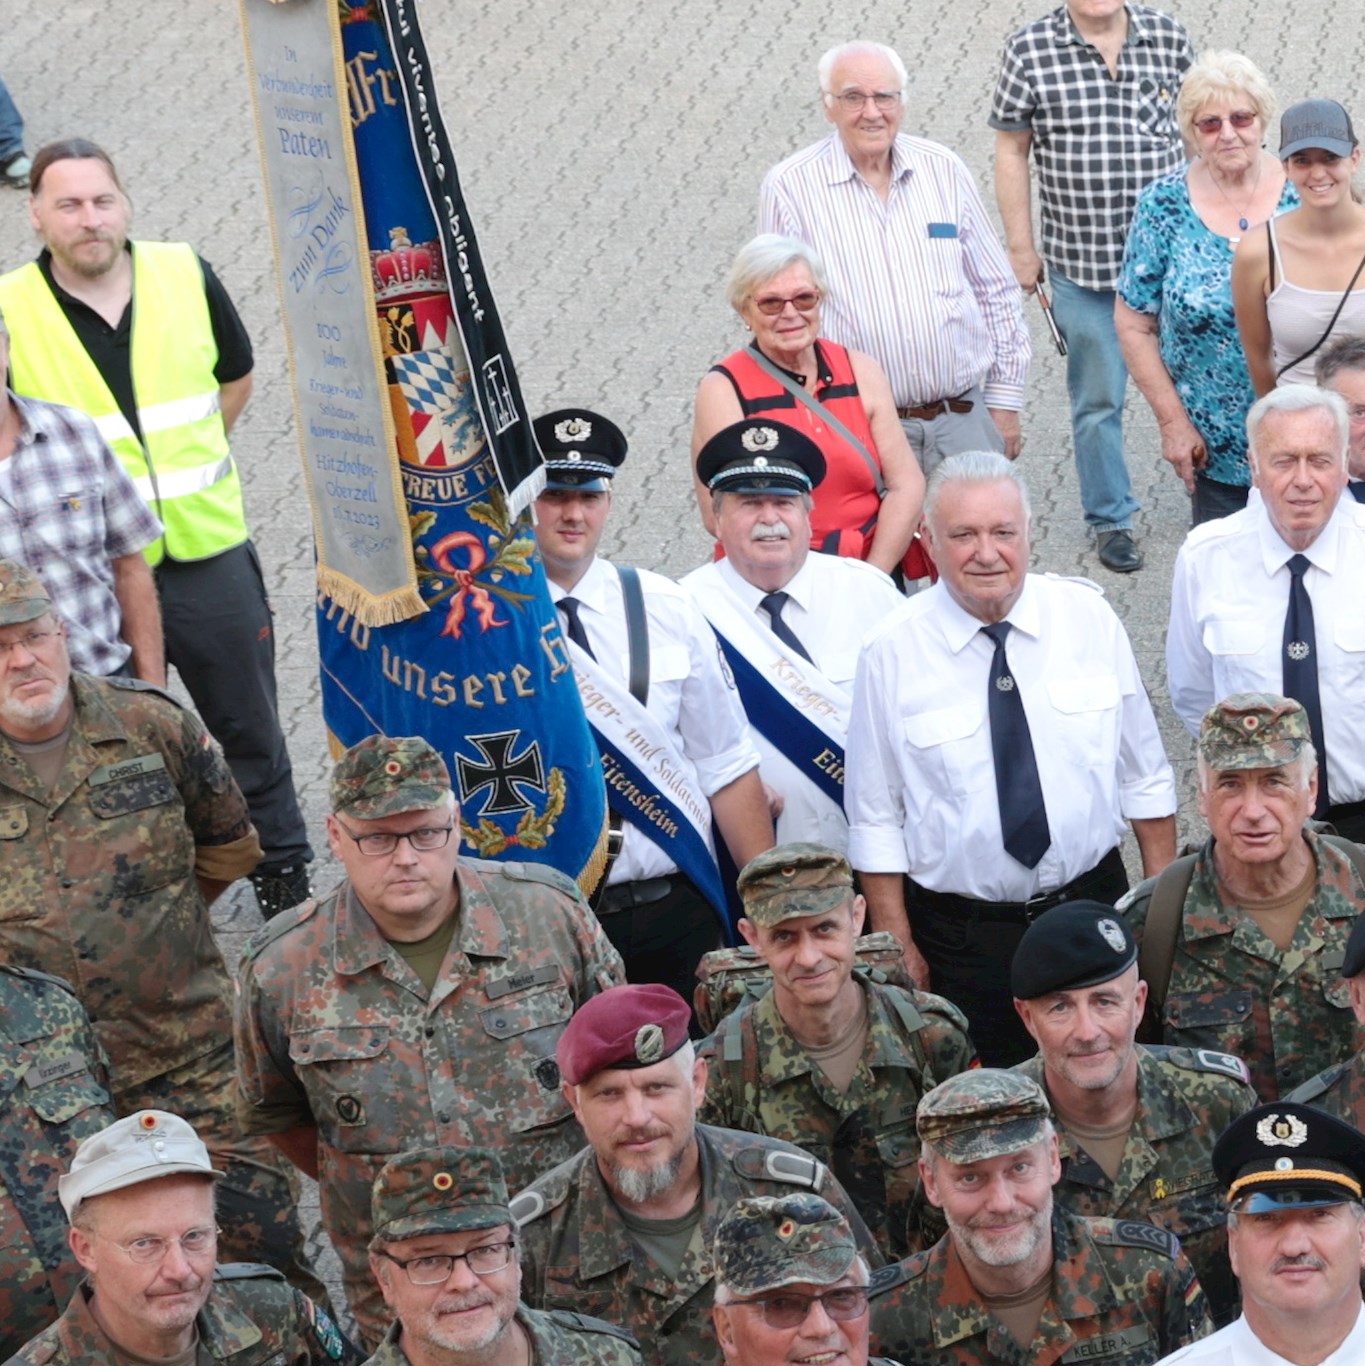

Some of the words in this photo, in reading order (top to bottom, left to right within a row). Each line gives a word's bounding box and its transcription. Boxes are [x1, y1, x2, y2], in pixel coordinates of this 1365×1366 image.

[277, 127, 333, 160] Paten
[311, 185, 350, 250] Dank
[324, 477, 378, 503] Oberzell
[380, 644, 536, 708] unsere
[770, 656, 842, 723] Krieger-
[624, 727, 659, 762] und
[108, 762, 144, 780] CHRIST
[600, 752, 680, 839] Eitensheim
[507, 974, 535, 990] Meier
[1073, 1337, 1115, 1358] KELLER
